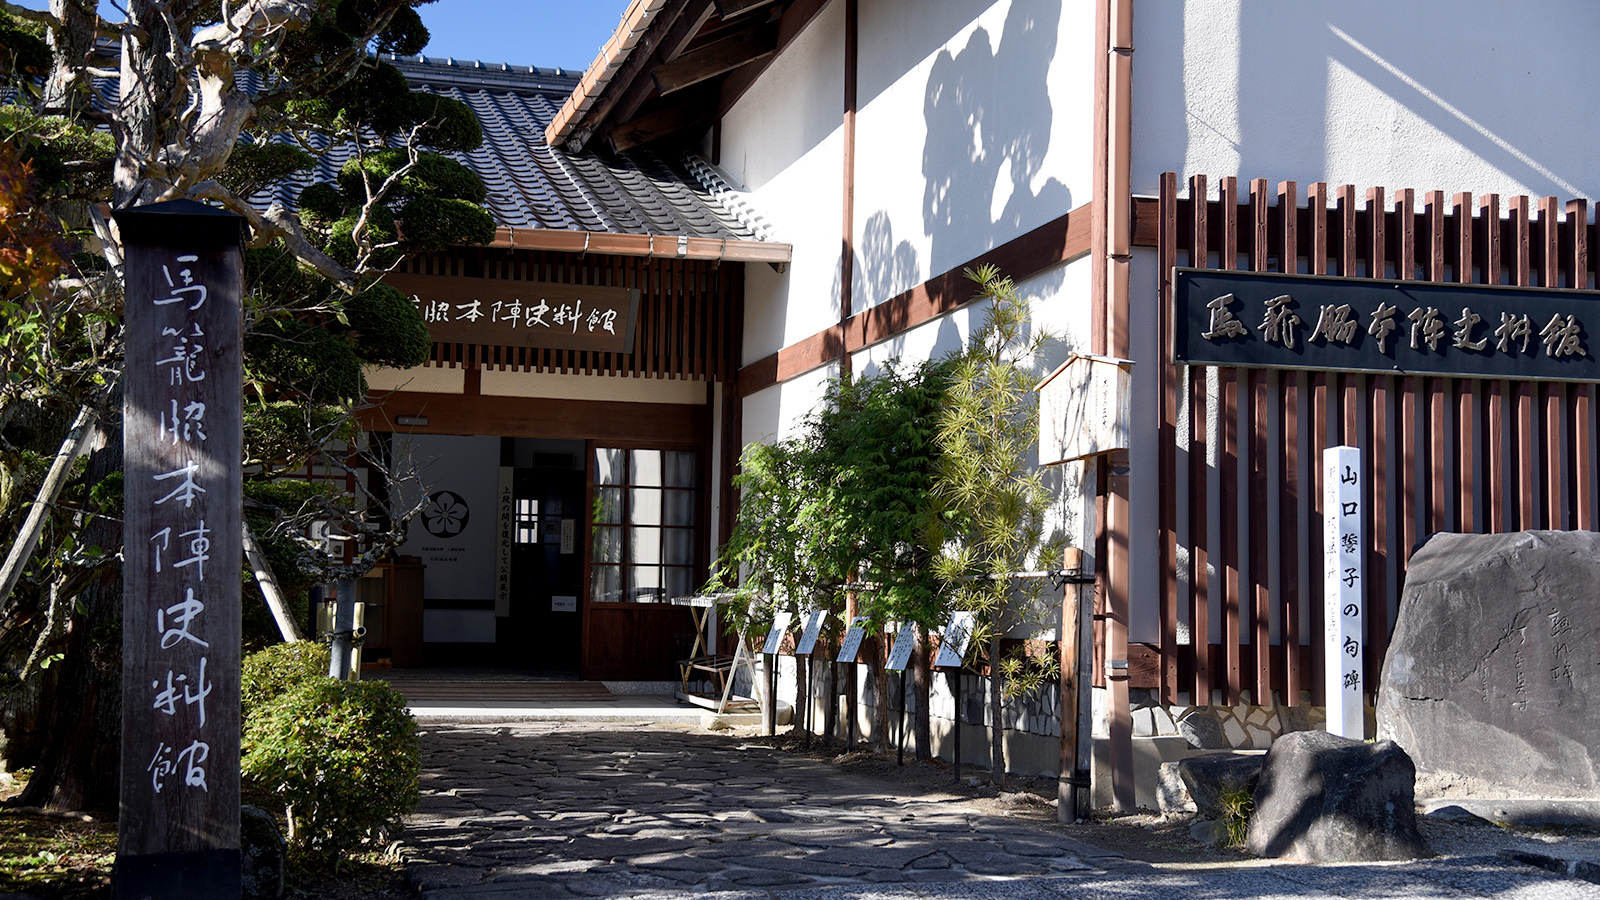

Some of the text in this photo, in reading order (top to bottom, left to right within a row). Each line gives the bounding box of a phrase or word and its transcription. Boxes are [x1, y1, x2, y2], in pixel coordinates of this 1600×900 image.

[406, 293, 618, 336] 脇本陣史料館
[147, 254, 212, 793] 馬籠脇本陣史料館
[499, 486, 511, 600] 上段の間を復元して公開展示
[1341, 465, 1361, 692] 山口誓子の句碑
